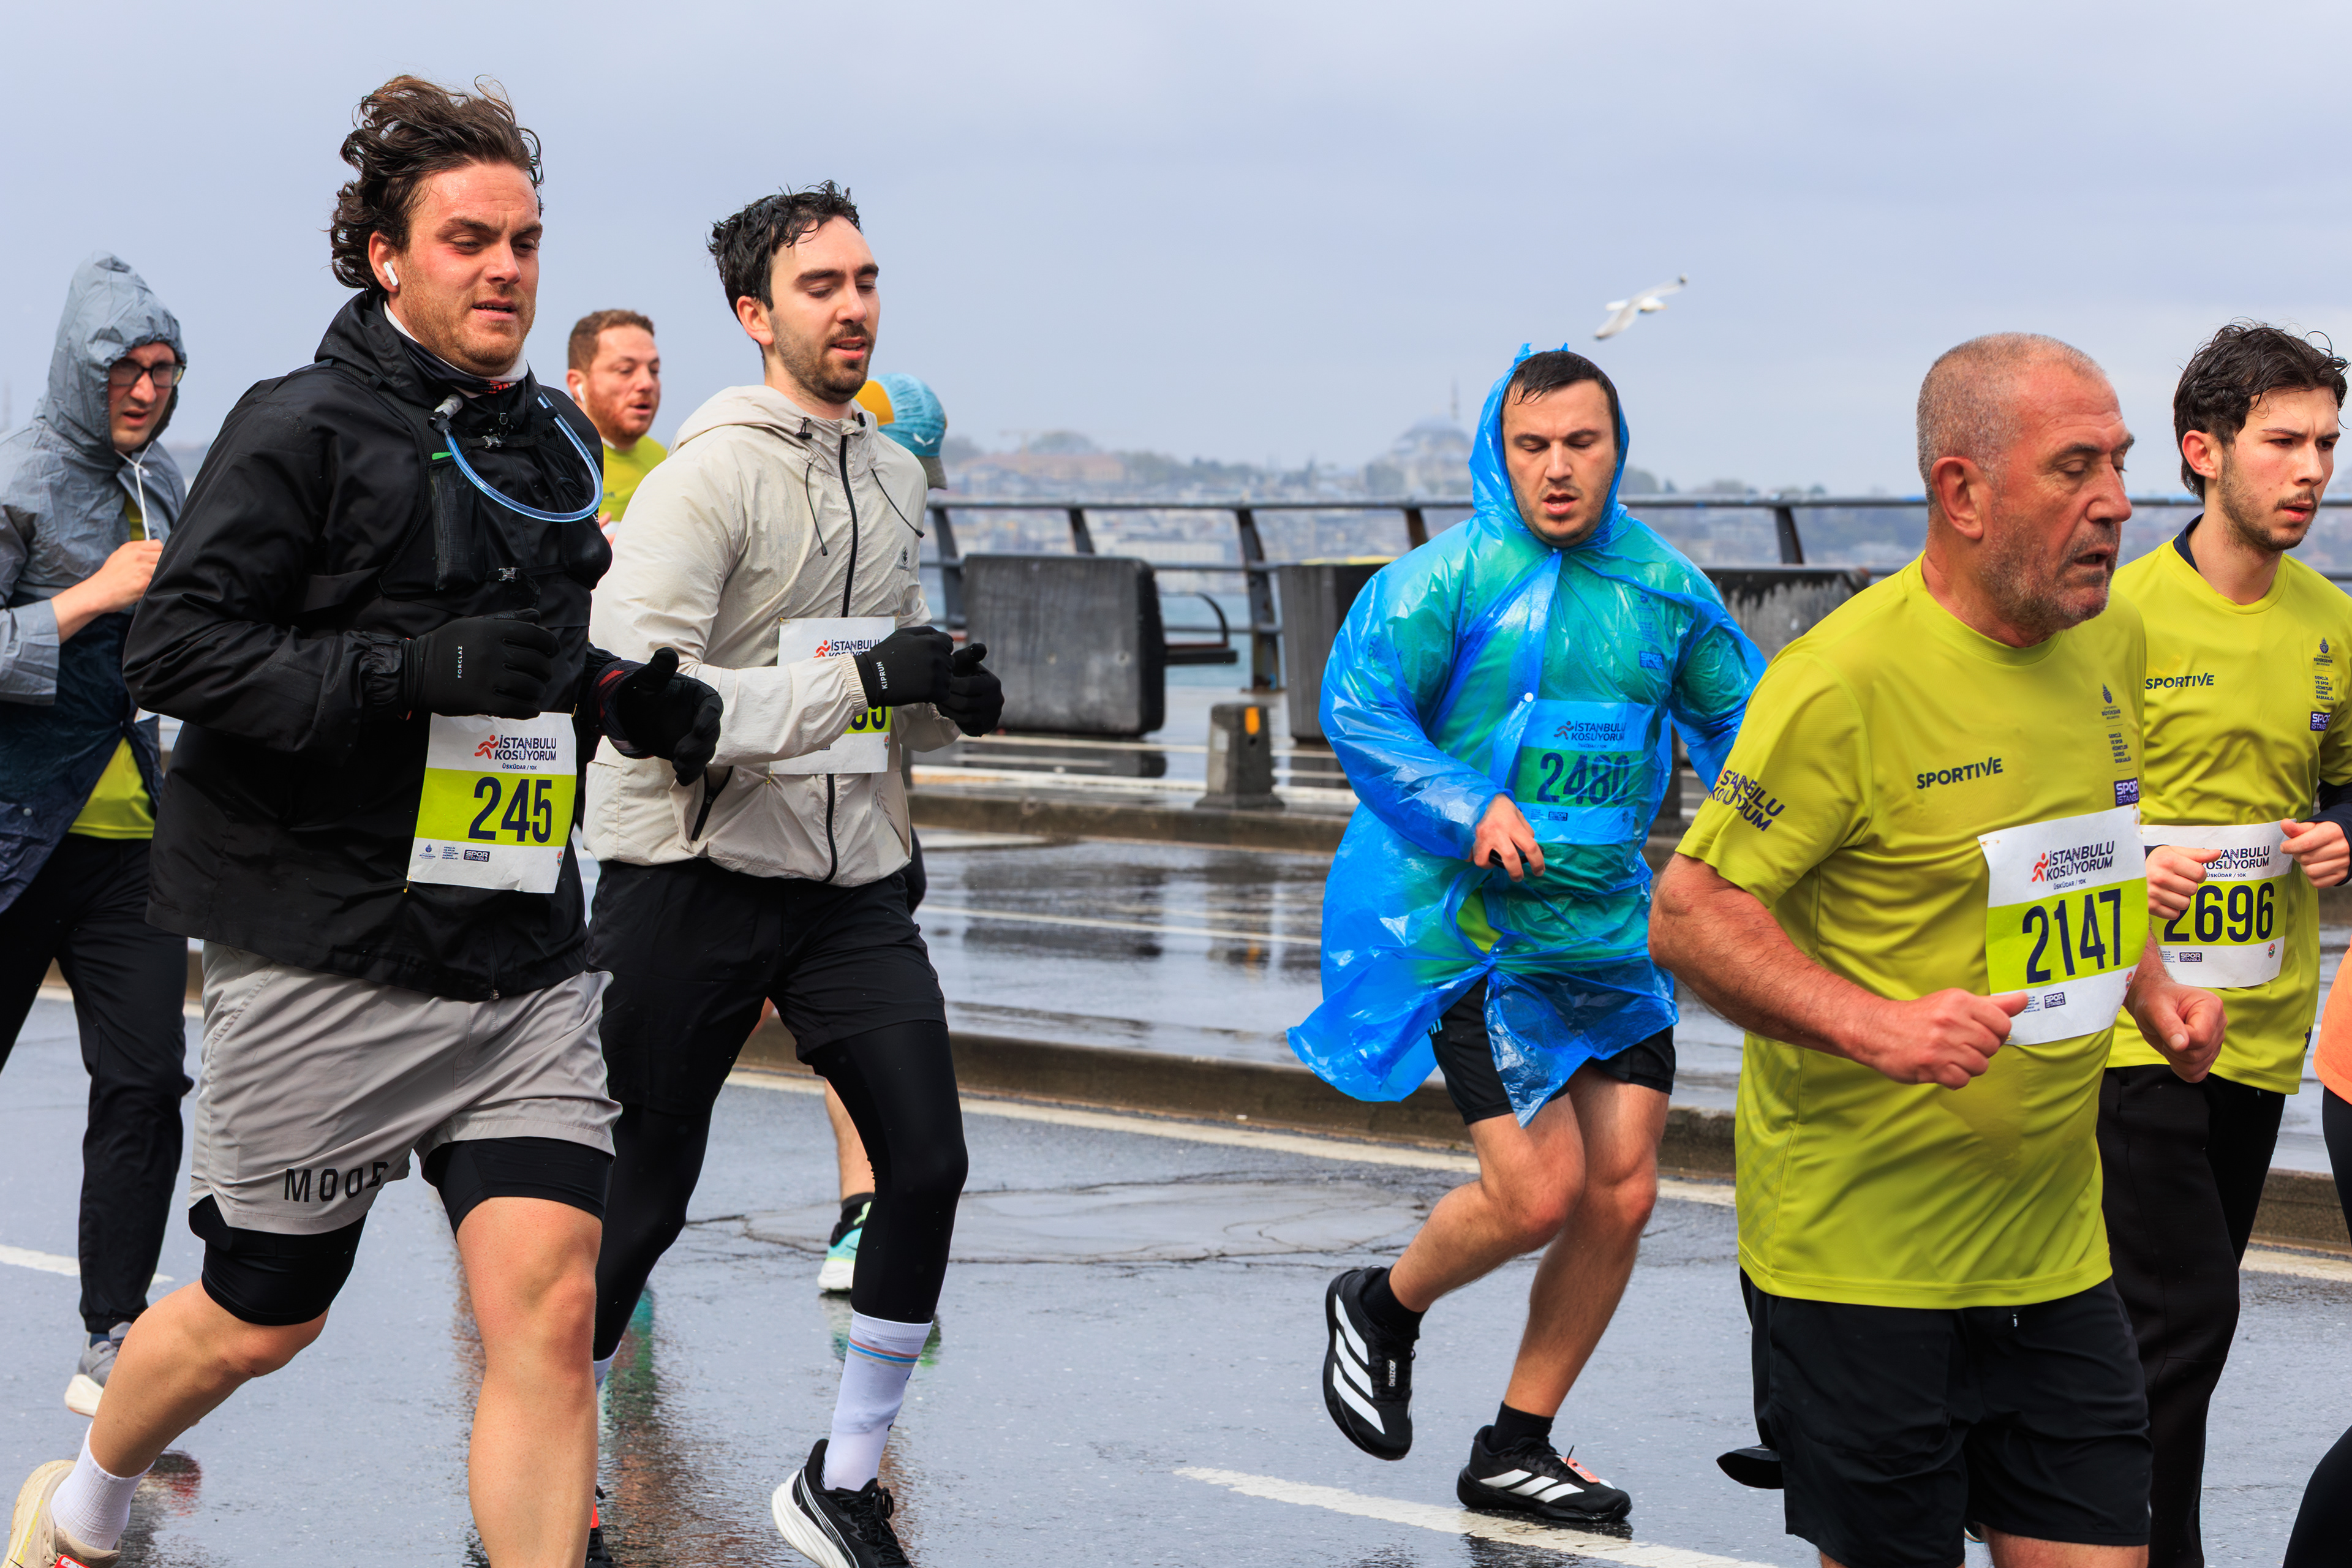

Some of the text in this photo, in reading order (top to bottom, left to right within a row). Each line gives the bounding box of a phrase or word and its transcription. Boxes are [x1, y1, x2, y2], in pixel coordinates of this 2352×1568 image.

[876, 662, 888, 690] KIPRUN
[2145, 673, 2215, 690] SPORTIVE
[499, 734, 557, 749] İSTANBULU
[1537, 752, 1630, 805] 2480
[1916, 757, 2003, 790] SPORTIVE
[2116, 780, 2139, 795] SPOR
[468, 776, 552, 843] 245
[2049, 840, 2115, 867] İSTANBULU
[2053, 880, 2075, 890] ÜSKÜDAR
[2163, 882, 2275, 943] 2696
[2022, 888, 2121, 984] 2147
[2046, 993, 2064, 1003] SPOR
